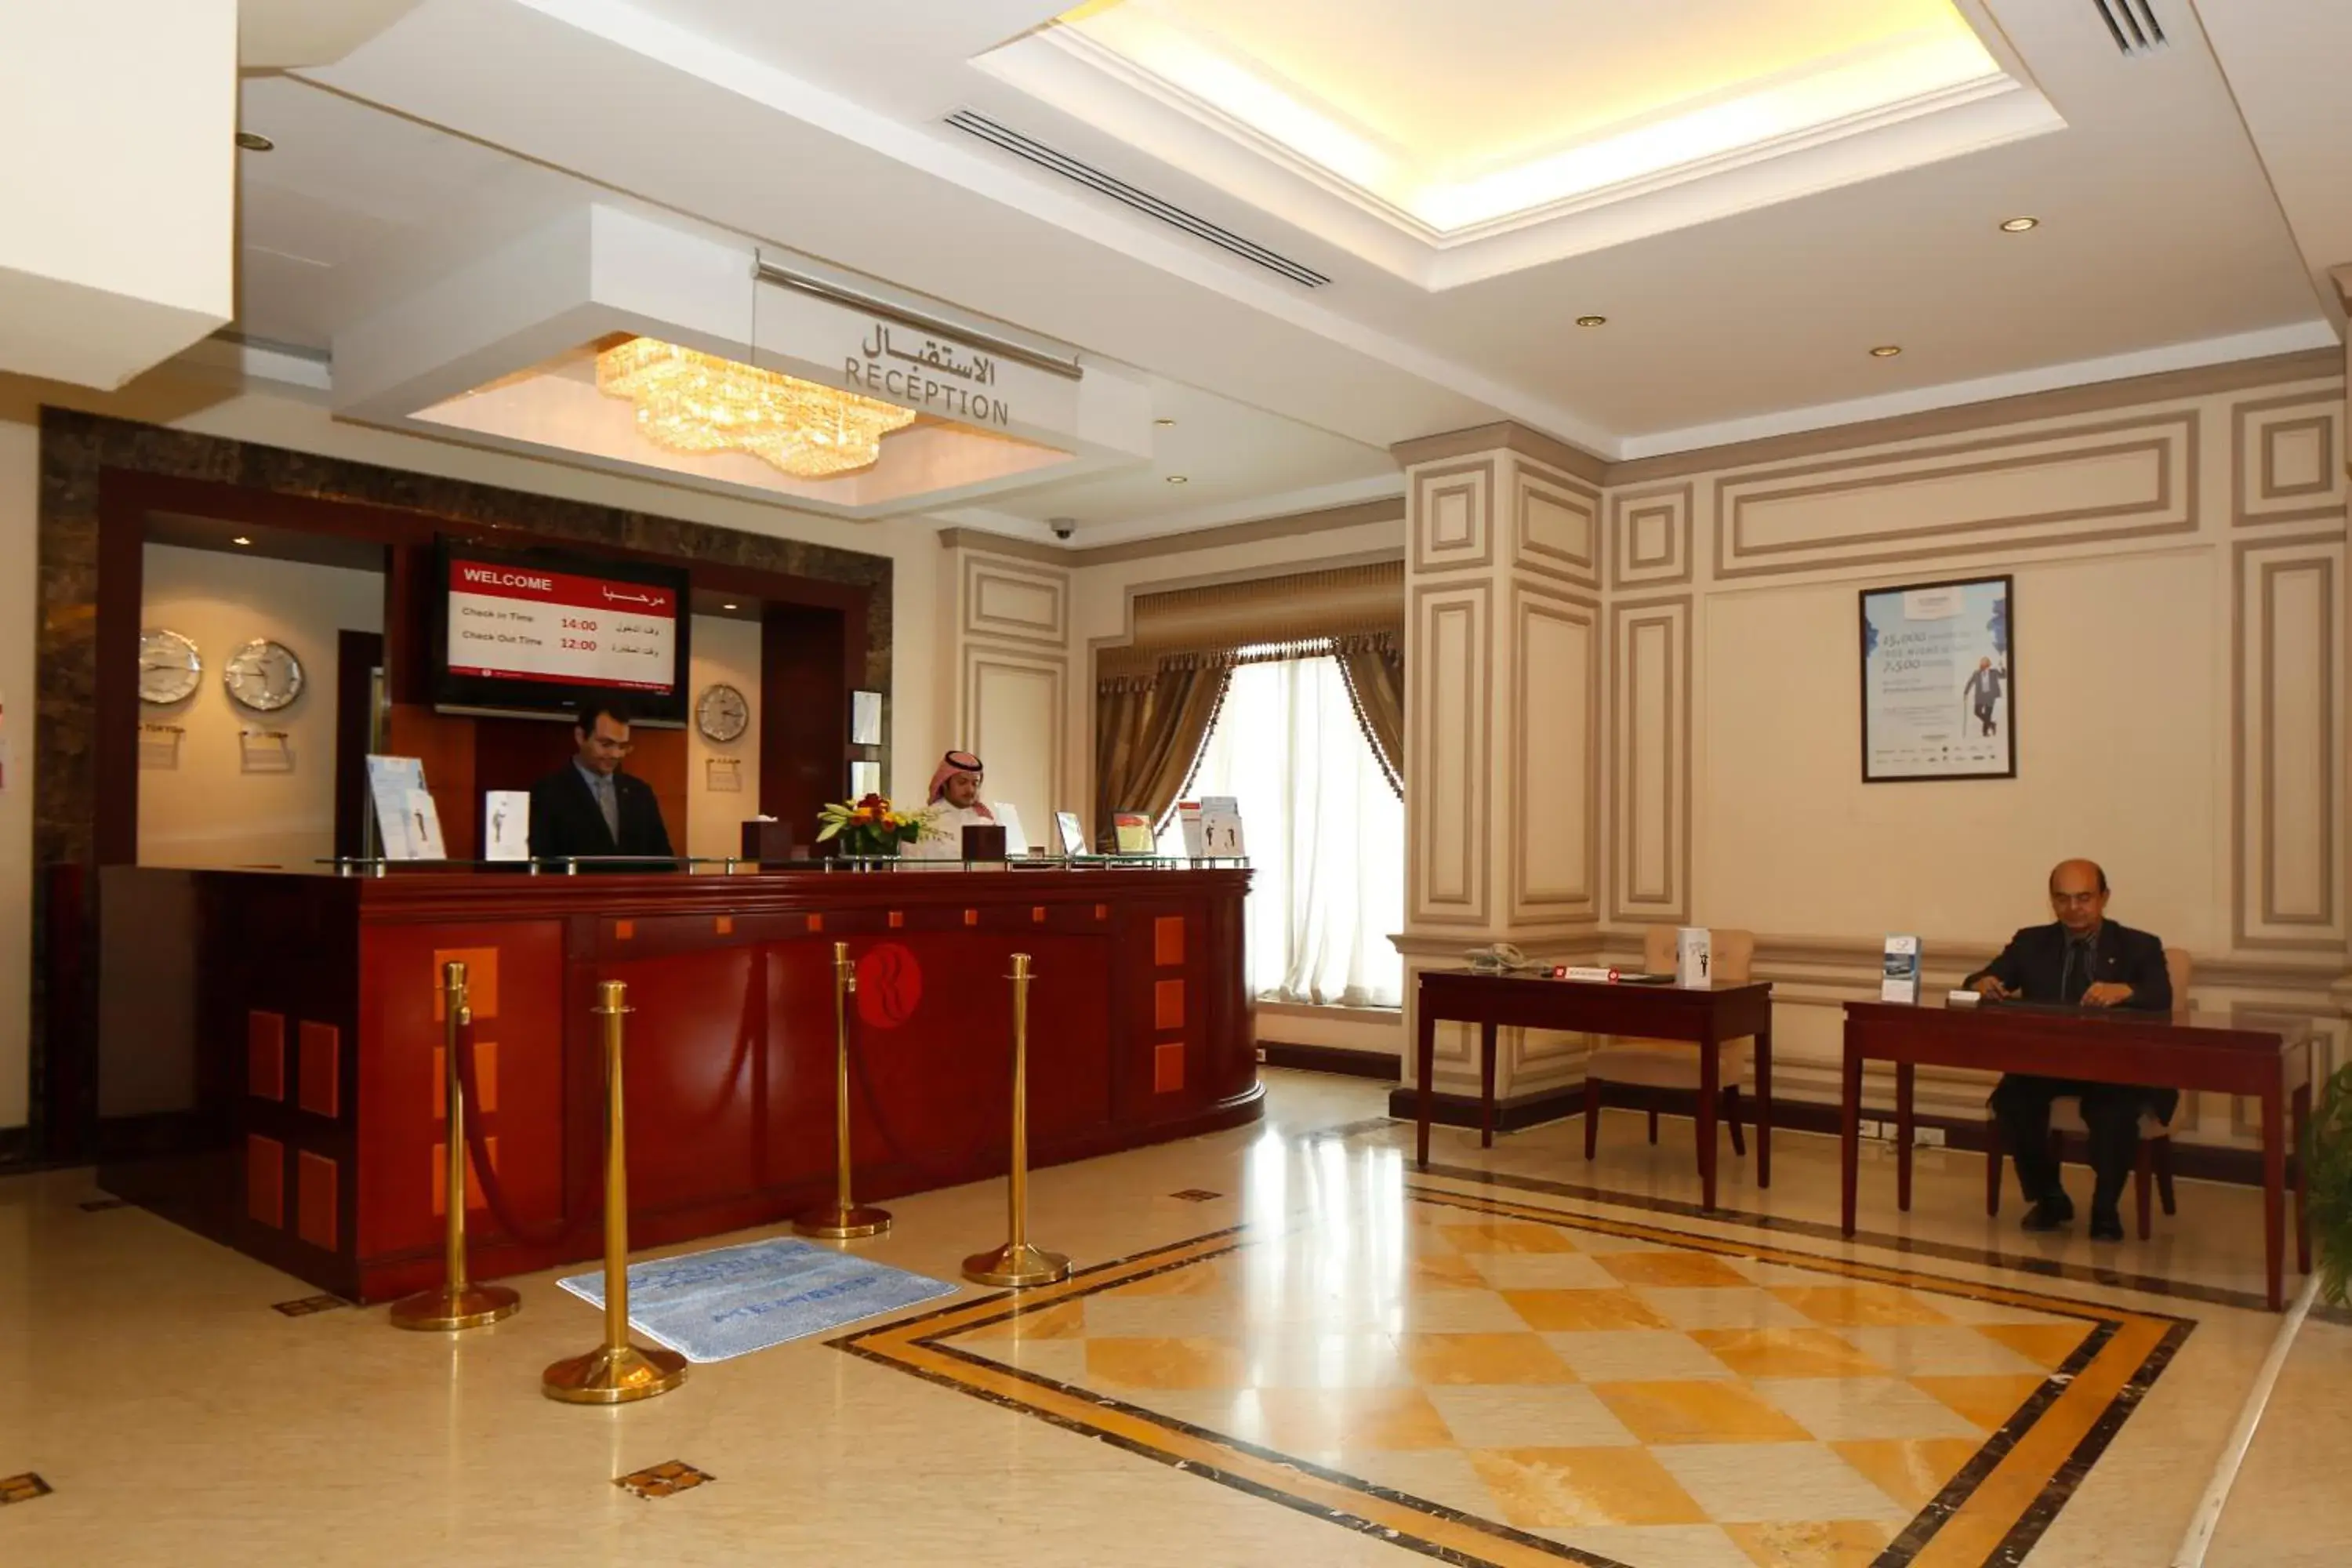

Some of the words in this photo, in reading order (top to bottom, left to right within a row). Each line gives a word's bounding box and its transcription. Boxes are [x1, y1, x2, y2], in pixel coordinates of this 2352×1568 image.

[862, 322, 996, 387] الاستقبال
[844, 356, 1009, 426] RECEPTION
[463, 568, 553, 592] WELCOME
[462, 607, 495, 618] Check
[510, 612, 534, 623] Time
[561, 618, 598, 632] 14:00
[462, 630, 495, 641] Check
[497, 634, 517, 644] Out
[518, 635, 543, 646] Time
[560, 637, 597, 652] 12:00
